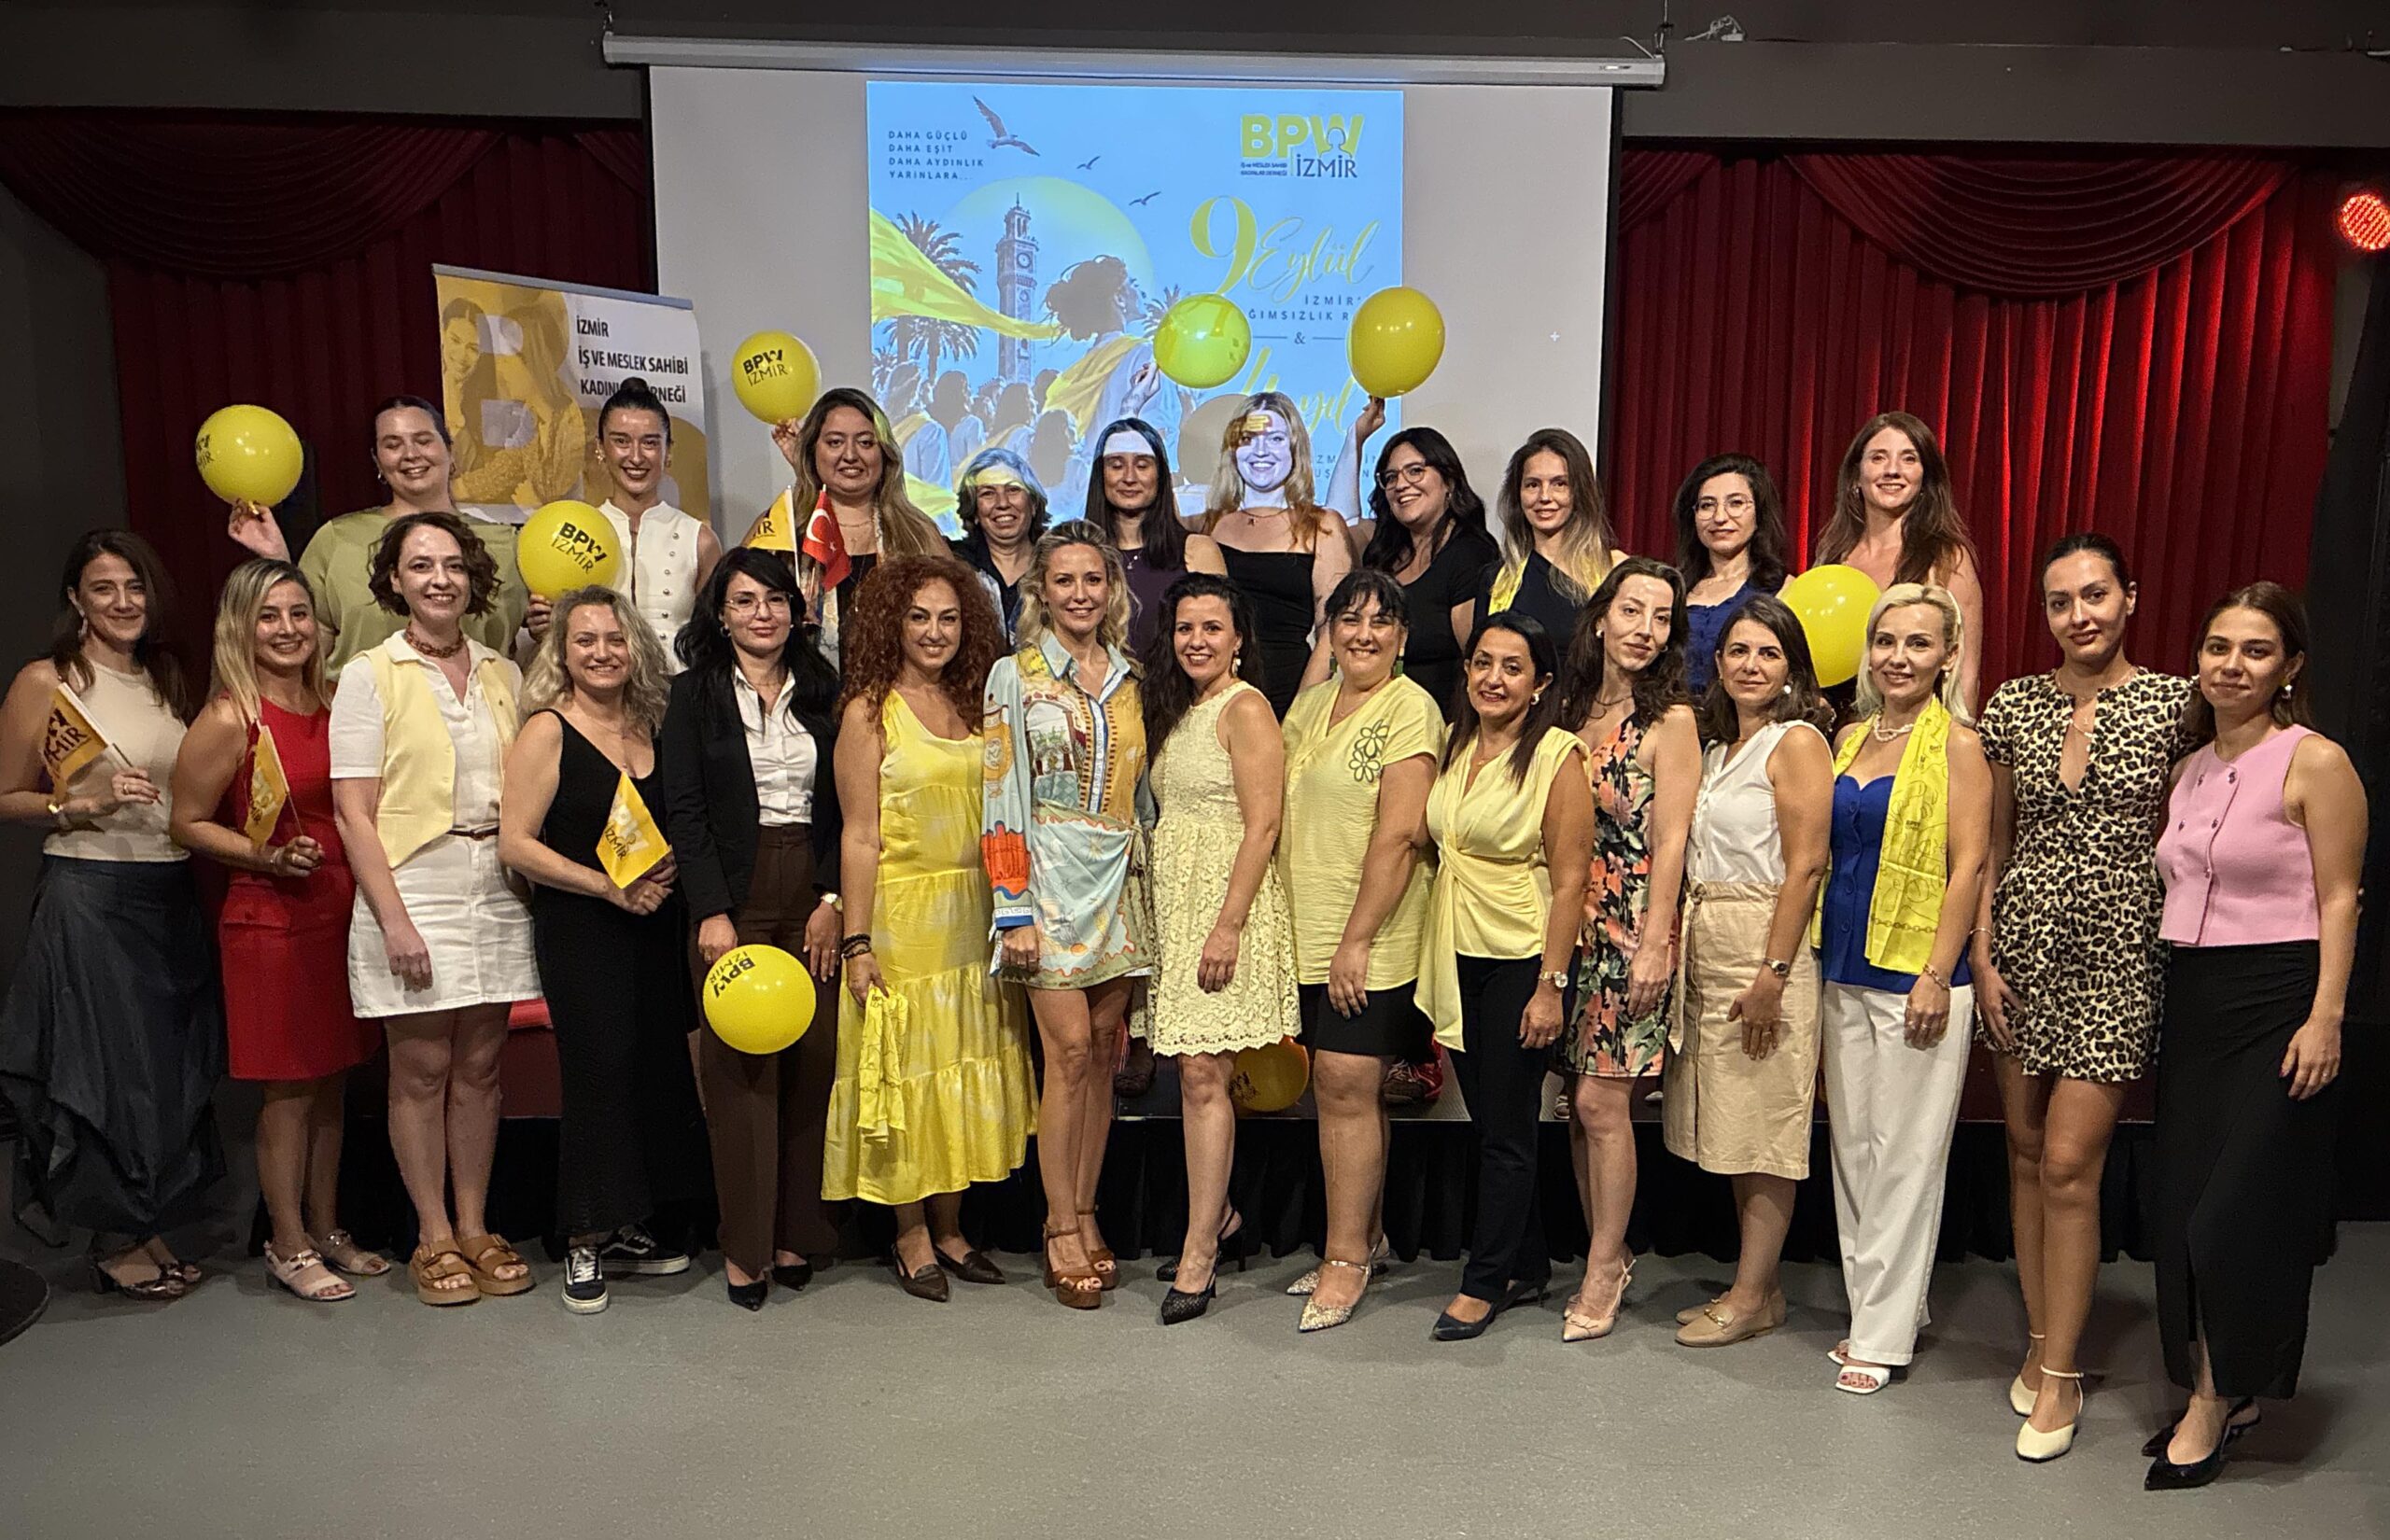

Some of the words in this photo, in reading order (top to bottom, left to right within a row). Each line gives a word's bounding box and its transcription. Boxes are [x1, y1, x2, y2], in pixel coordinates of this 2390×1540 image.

[888, 131, 921, 139] DAHA
[926, 130, 967, 142] GÜÇLÜ
[888, 144, 921, 152] DAHA
[1242, 114, 1364, 158] BPW
[889, 157, 921, 165] DAHA
[926, 158, 984, 167] AYDINLIK
[1296, 153, 1357, 178] İZMİR
[1189, 195, 1258, 295] 9
[1246, 216, 1382, 304] Eylül
[1304, 294, 1361, 306] İZMİR'
[576, 315, 609, 337] İZMİR
[1248, 309, 1332, 321] ĞIMSIZLIK
[578, 345, 590, 369] İŞ
[591, 350, 605, 367] VE
[607, 352, 647, 371] MESLEK
[648, 355, 689, 375] SAHİBİ
[742, 349, 783, 374] BPW
[559, 522, 608, 563] BPW
[713, 957, 756, 999] BPW
